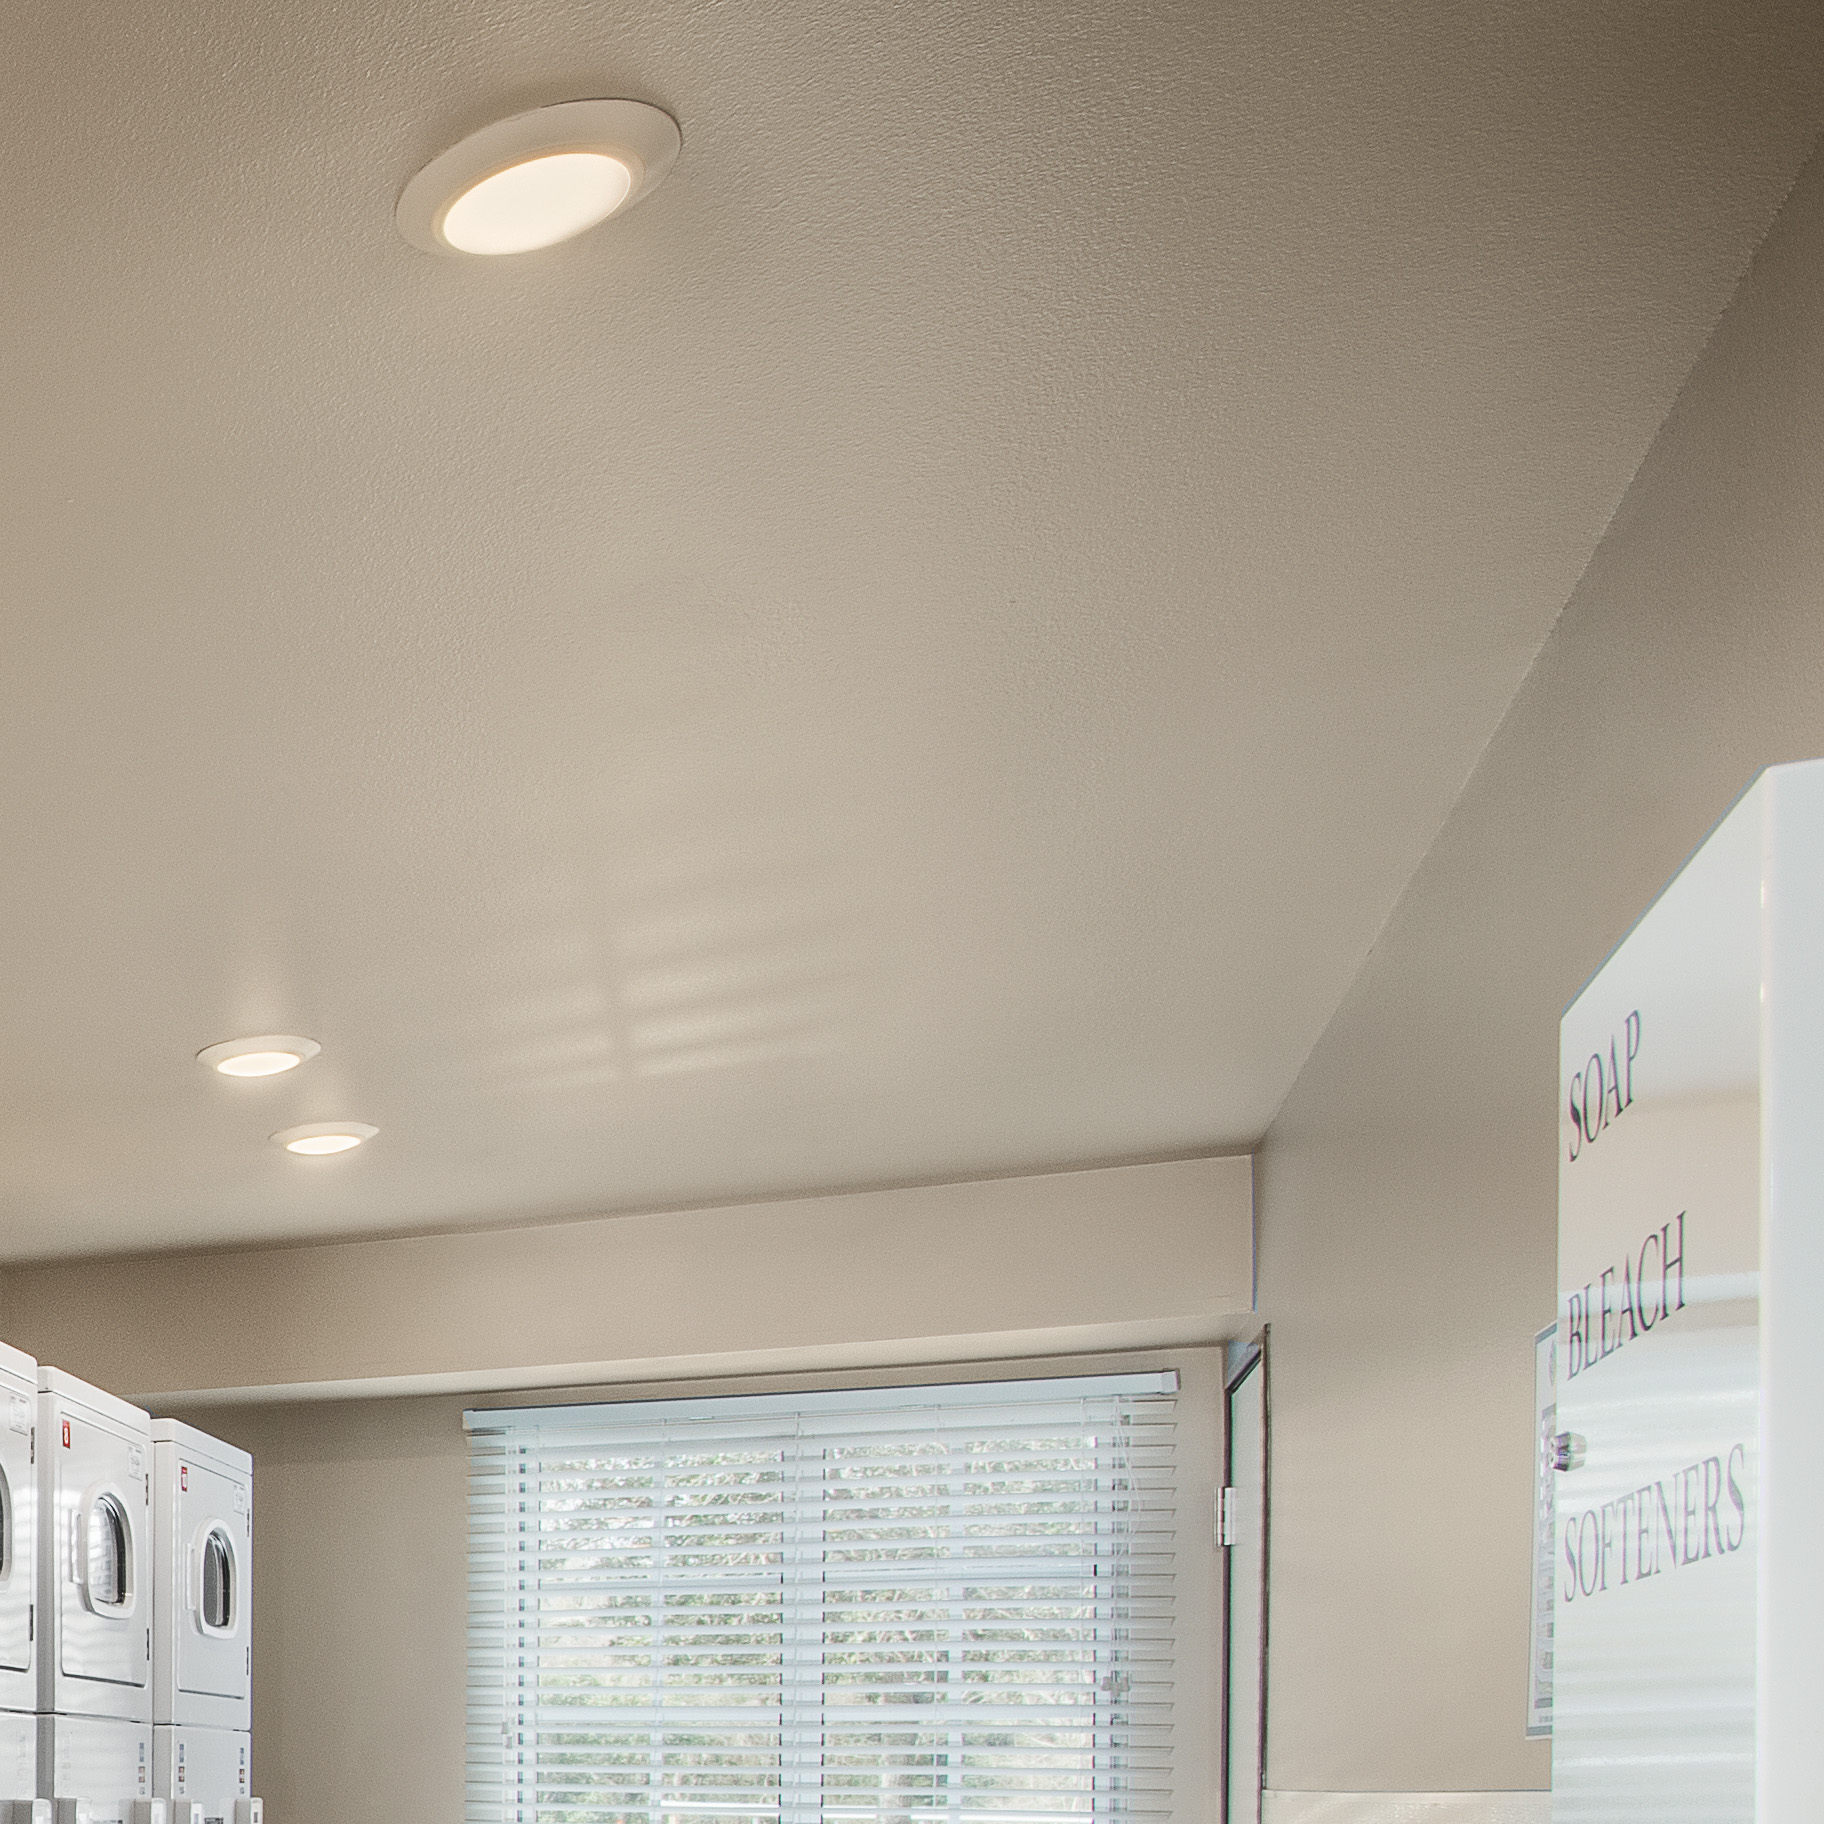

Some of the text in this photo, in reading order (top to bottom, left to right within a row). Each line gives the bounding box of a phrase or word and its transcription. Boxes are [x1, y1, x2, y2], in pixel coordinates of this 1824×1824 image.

[1569, 1010, 1640, 1162] SOAP
[1568, 1210, 1686, 1380] BLEACH
[1564, 1443, 1744, 1602] SOFTENERS
